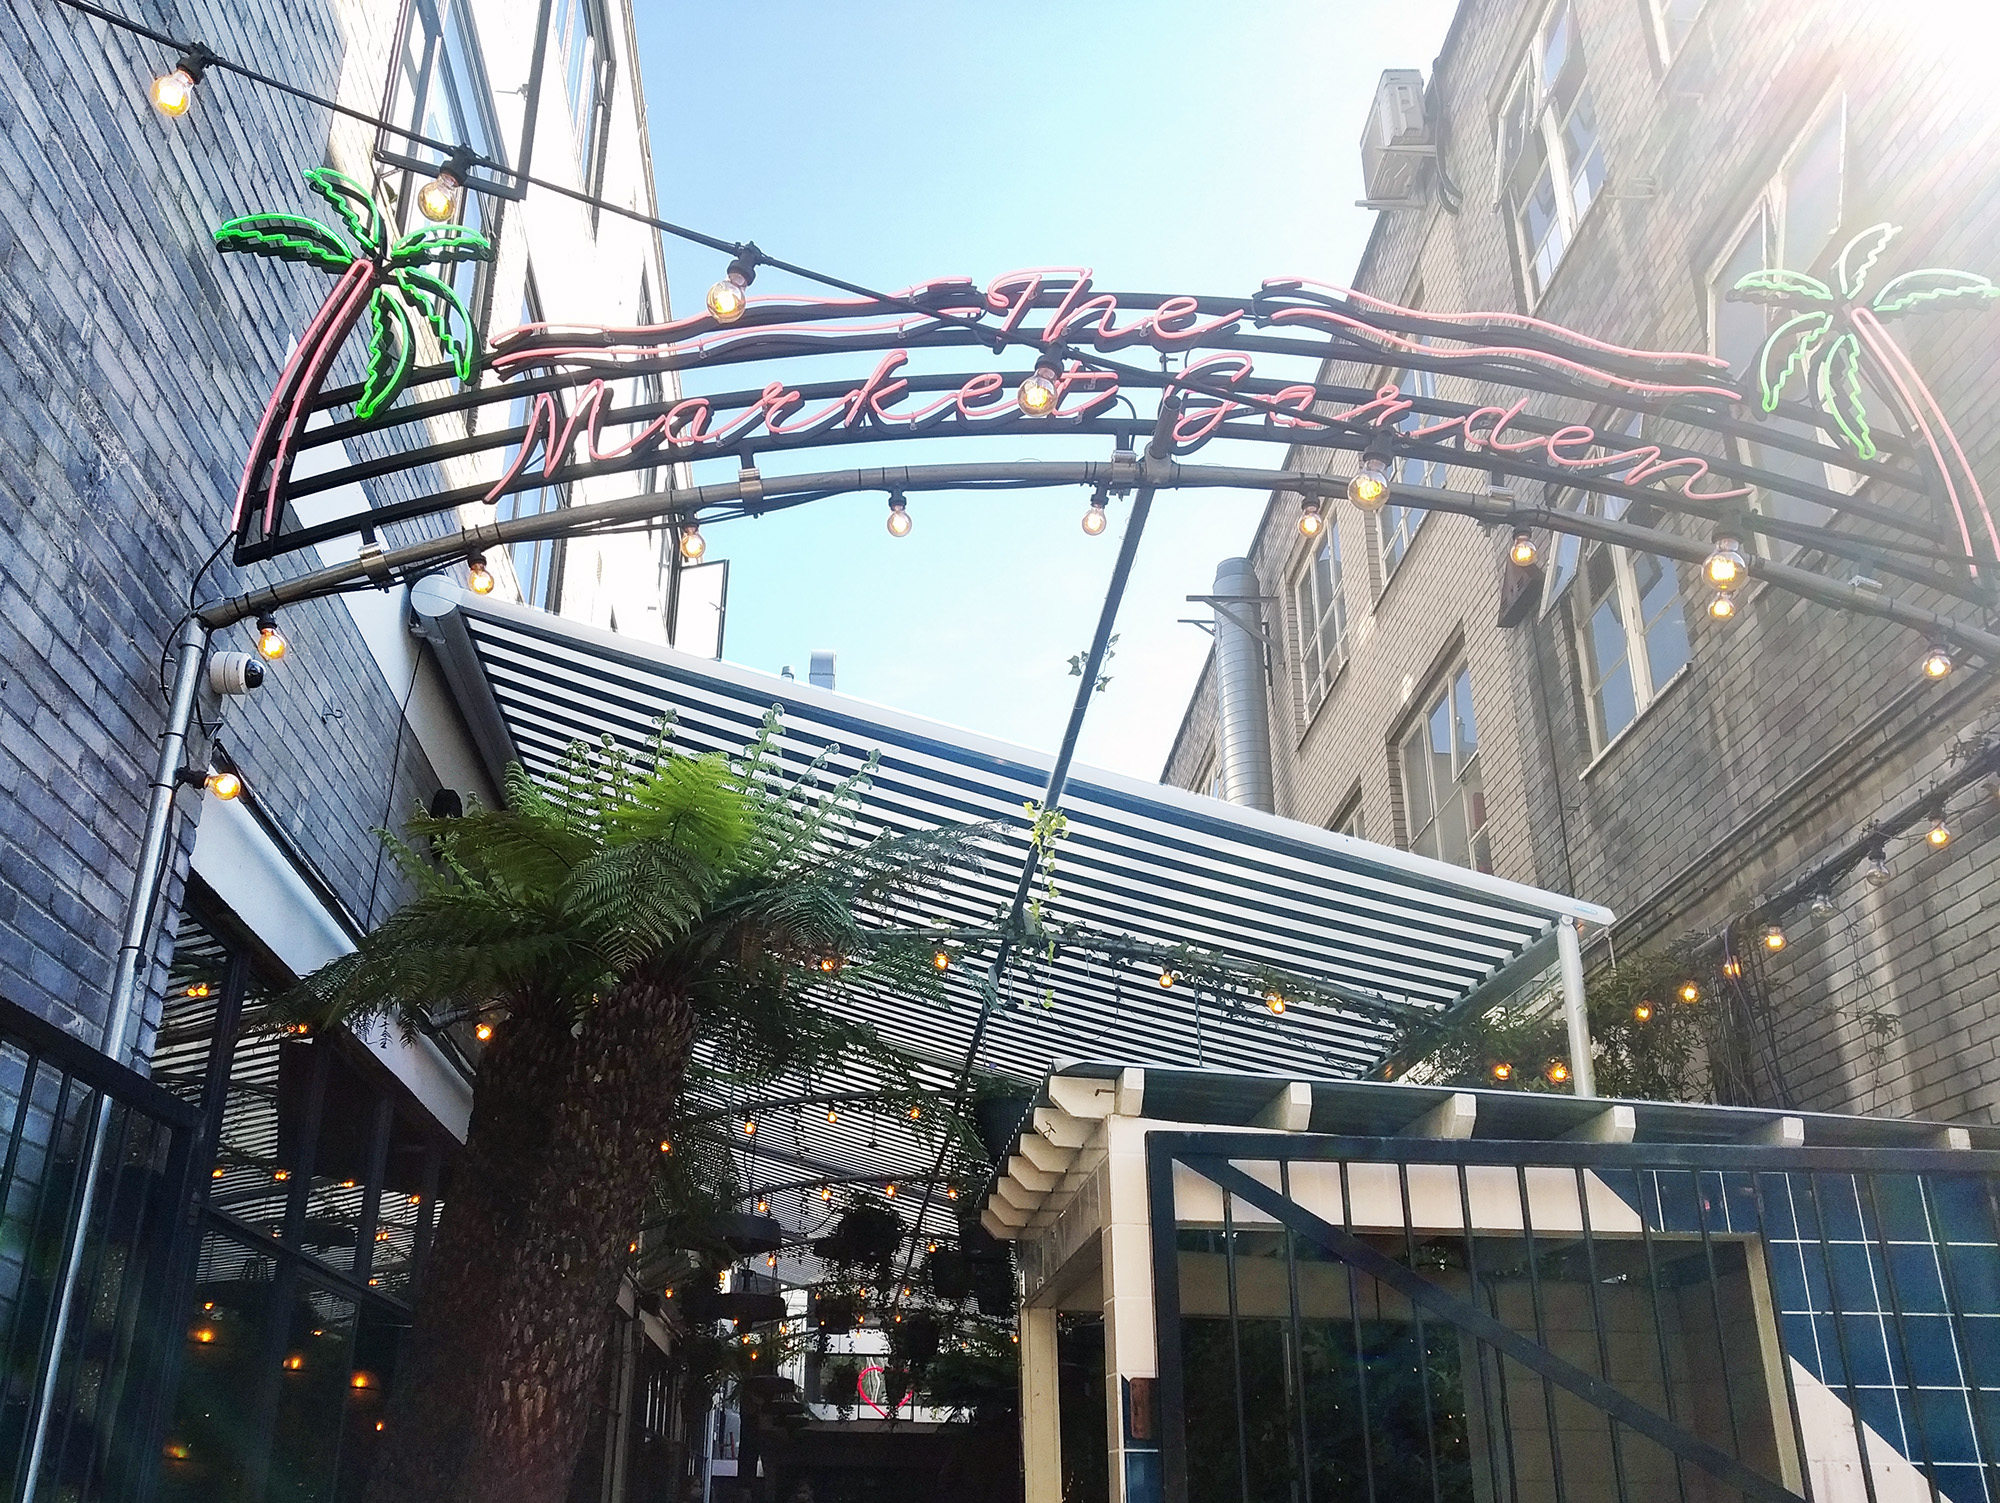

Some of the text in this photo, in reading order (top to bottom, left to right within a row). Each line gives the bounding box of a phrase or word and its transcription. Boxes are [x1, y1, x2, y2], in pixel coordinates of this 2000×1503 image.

[986, 266, 1245, 343] The
[484, 349, 1758, 503] Market Garden
